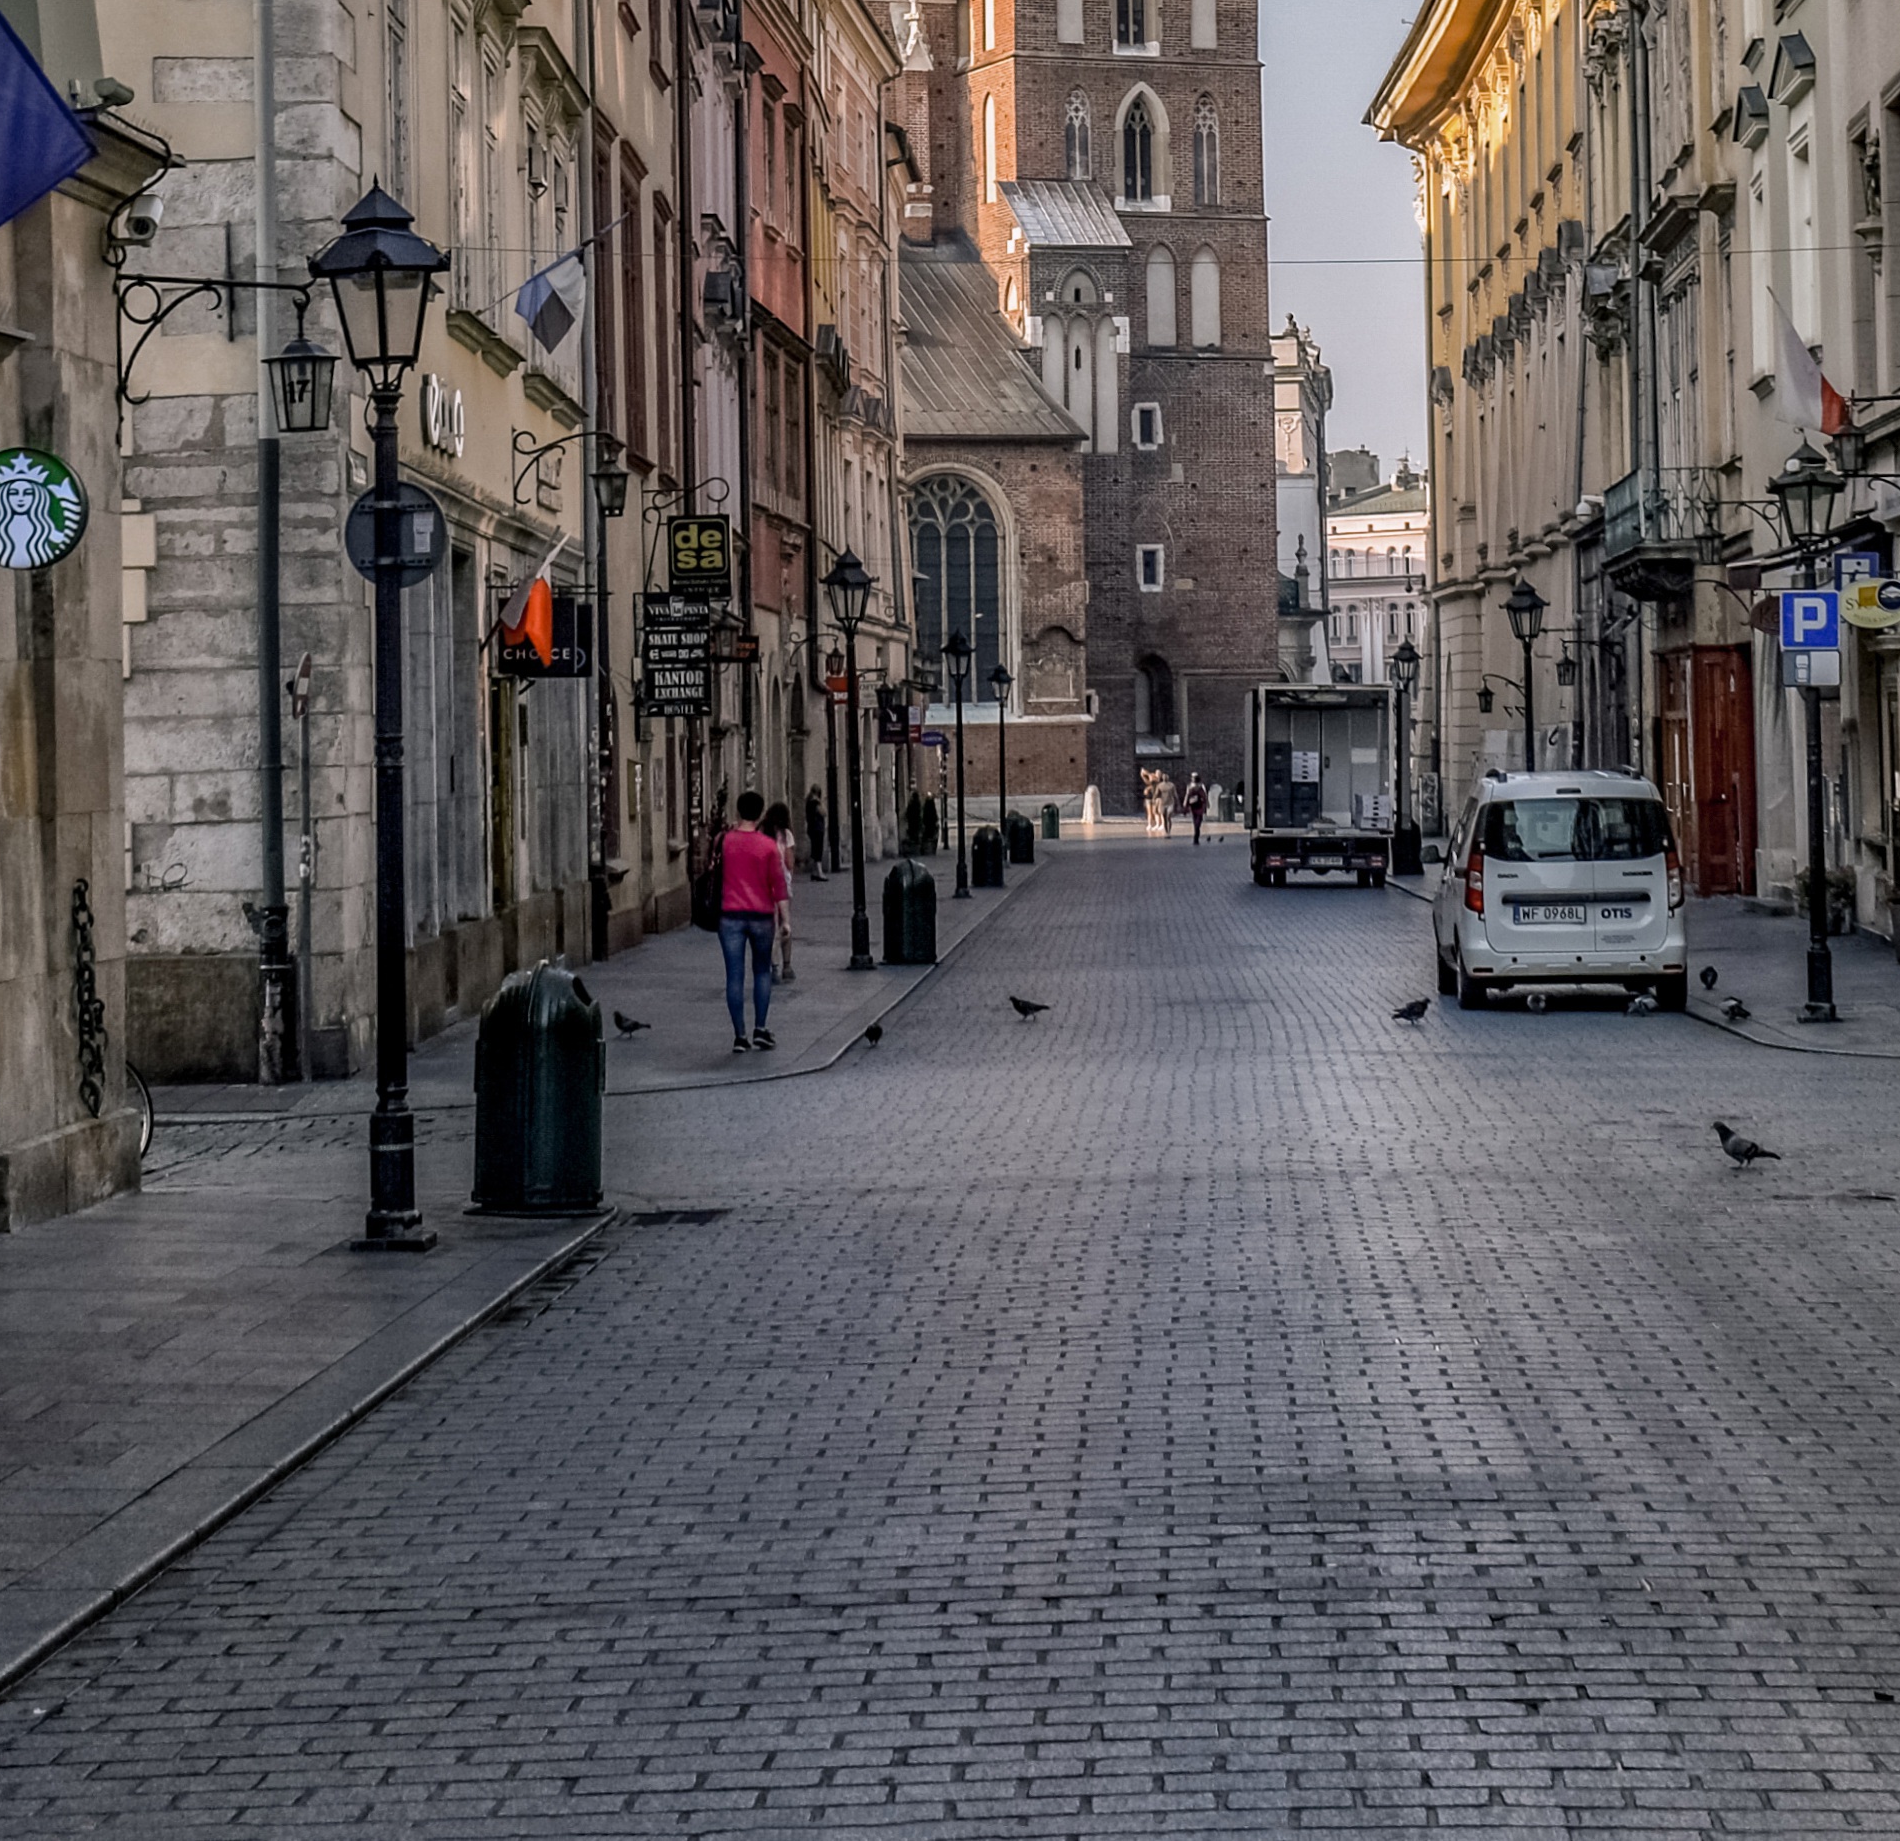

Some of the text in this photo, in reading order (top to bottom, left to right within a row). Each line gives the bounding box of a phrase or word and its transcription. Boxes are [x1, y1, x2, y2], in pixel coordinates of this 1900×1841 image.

[286, 379, 311, 404] 17
[1793, 597, 1827, 643] P
[648, 632, 708, 646] SKATE SHOP
[502, 647, 571, 660] CHOCE
[654, 670, 705, 686] KANTOR
[654, 686, 705, 700] EXCHANGE
[1521, 907, 1583, 921] WF 0968L
[1601, 907, 1633, 919] OTIS
